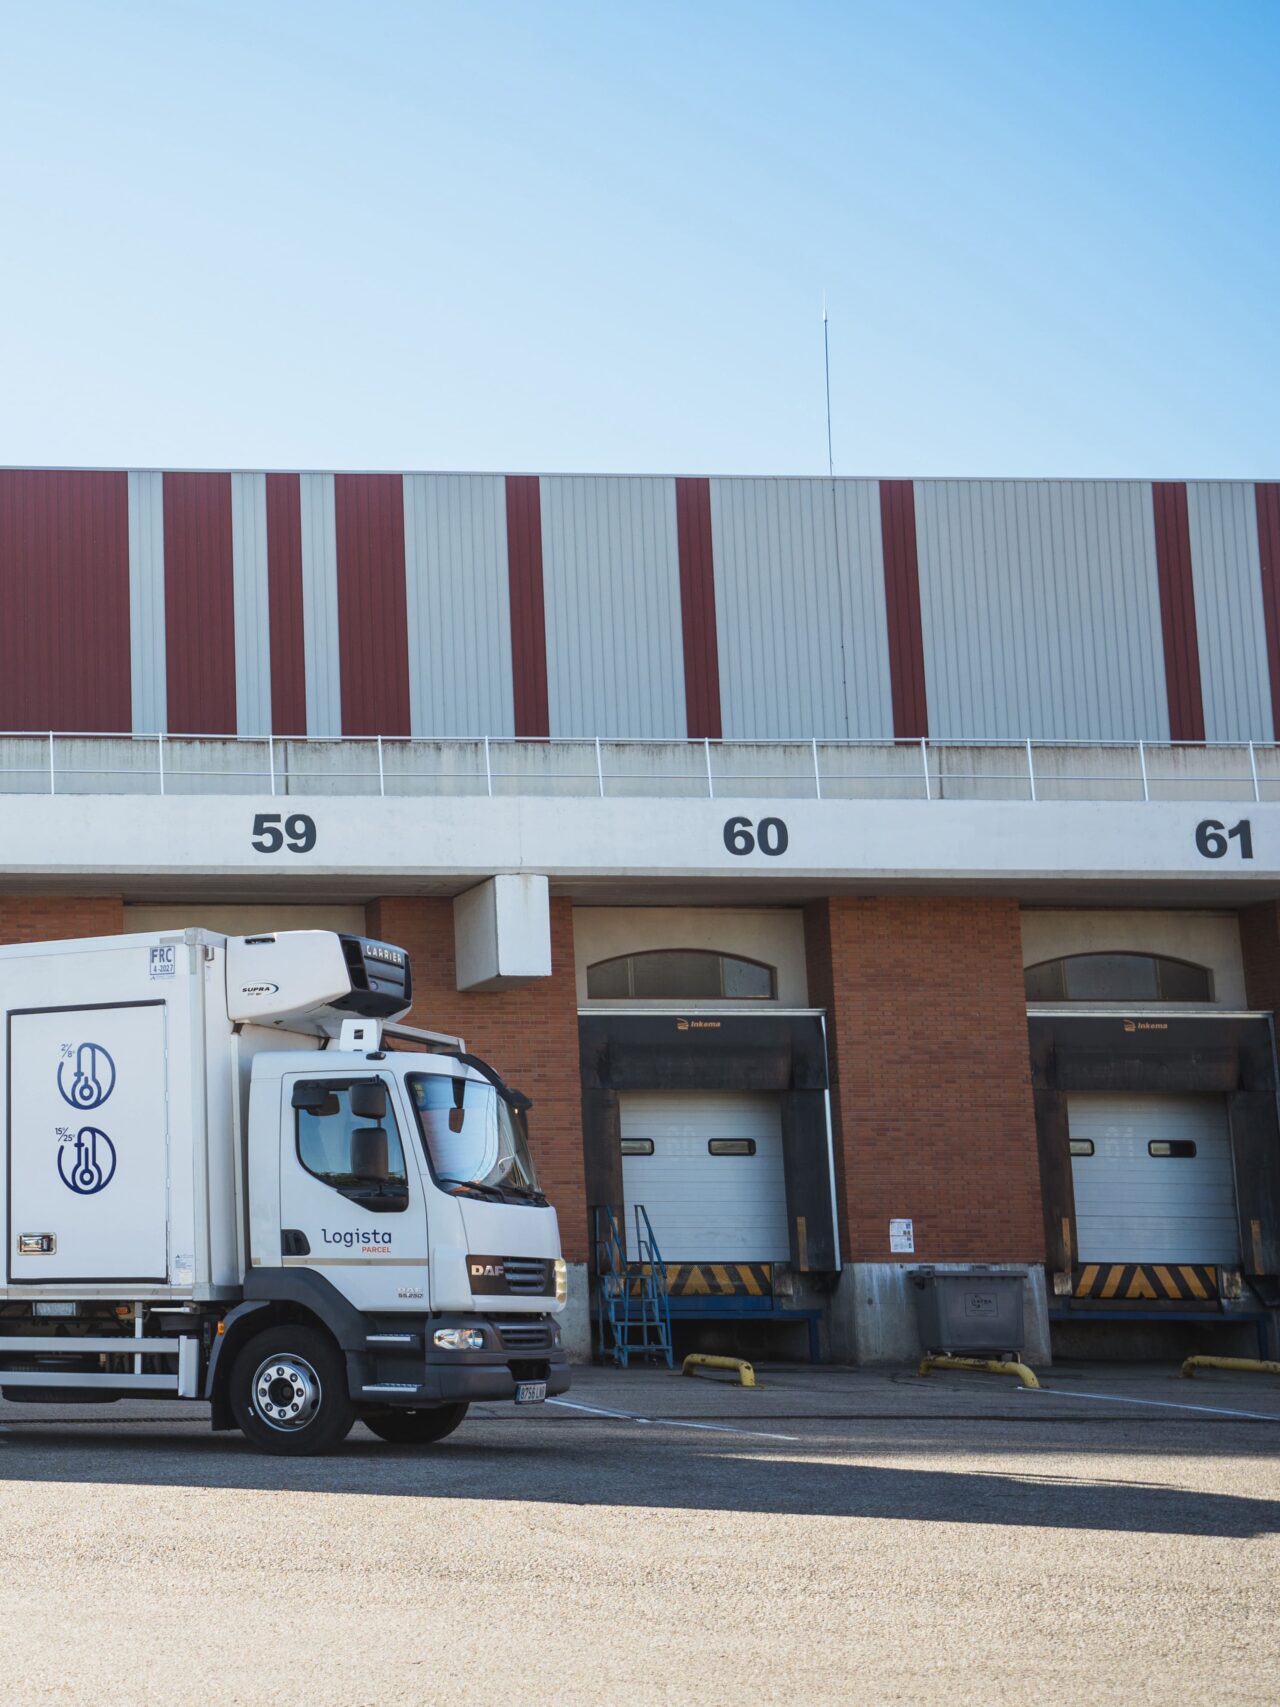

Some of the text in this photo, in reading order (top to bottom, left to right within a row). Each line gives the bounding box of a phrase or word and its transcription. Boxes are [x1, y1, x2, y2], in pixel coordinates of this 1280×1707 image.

[251, 813, 317, 854] 59
[723, 816, 790, 858] 60
[1195, 819, 1255, 861] 61
[151, 948, 172, 963] FRC
[366, 945, 402, 963] CARRIER
[321, 1228, 392, 1247] logista
[471, 1264, 504, 1276] DAF
